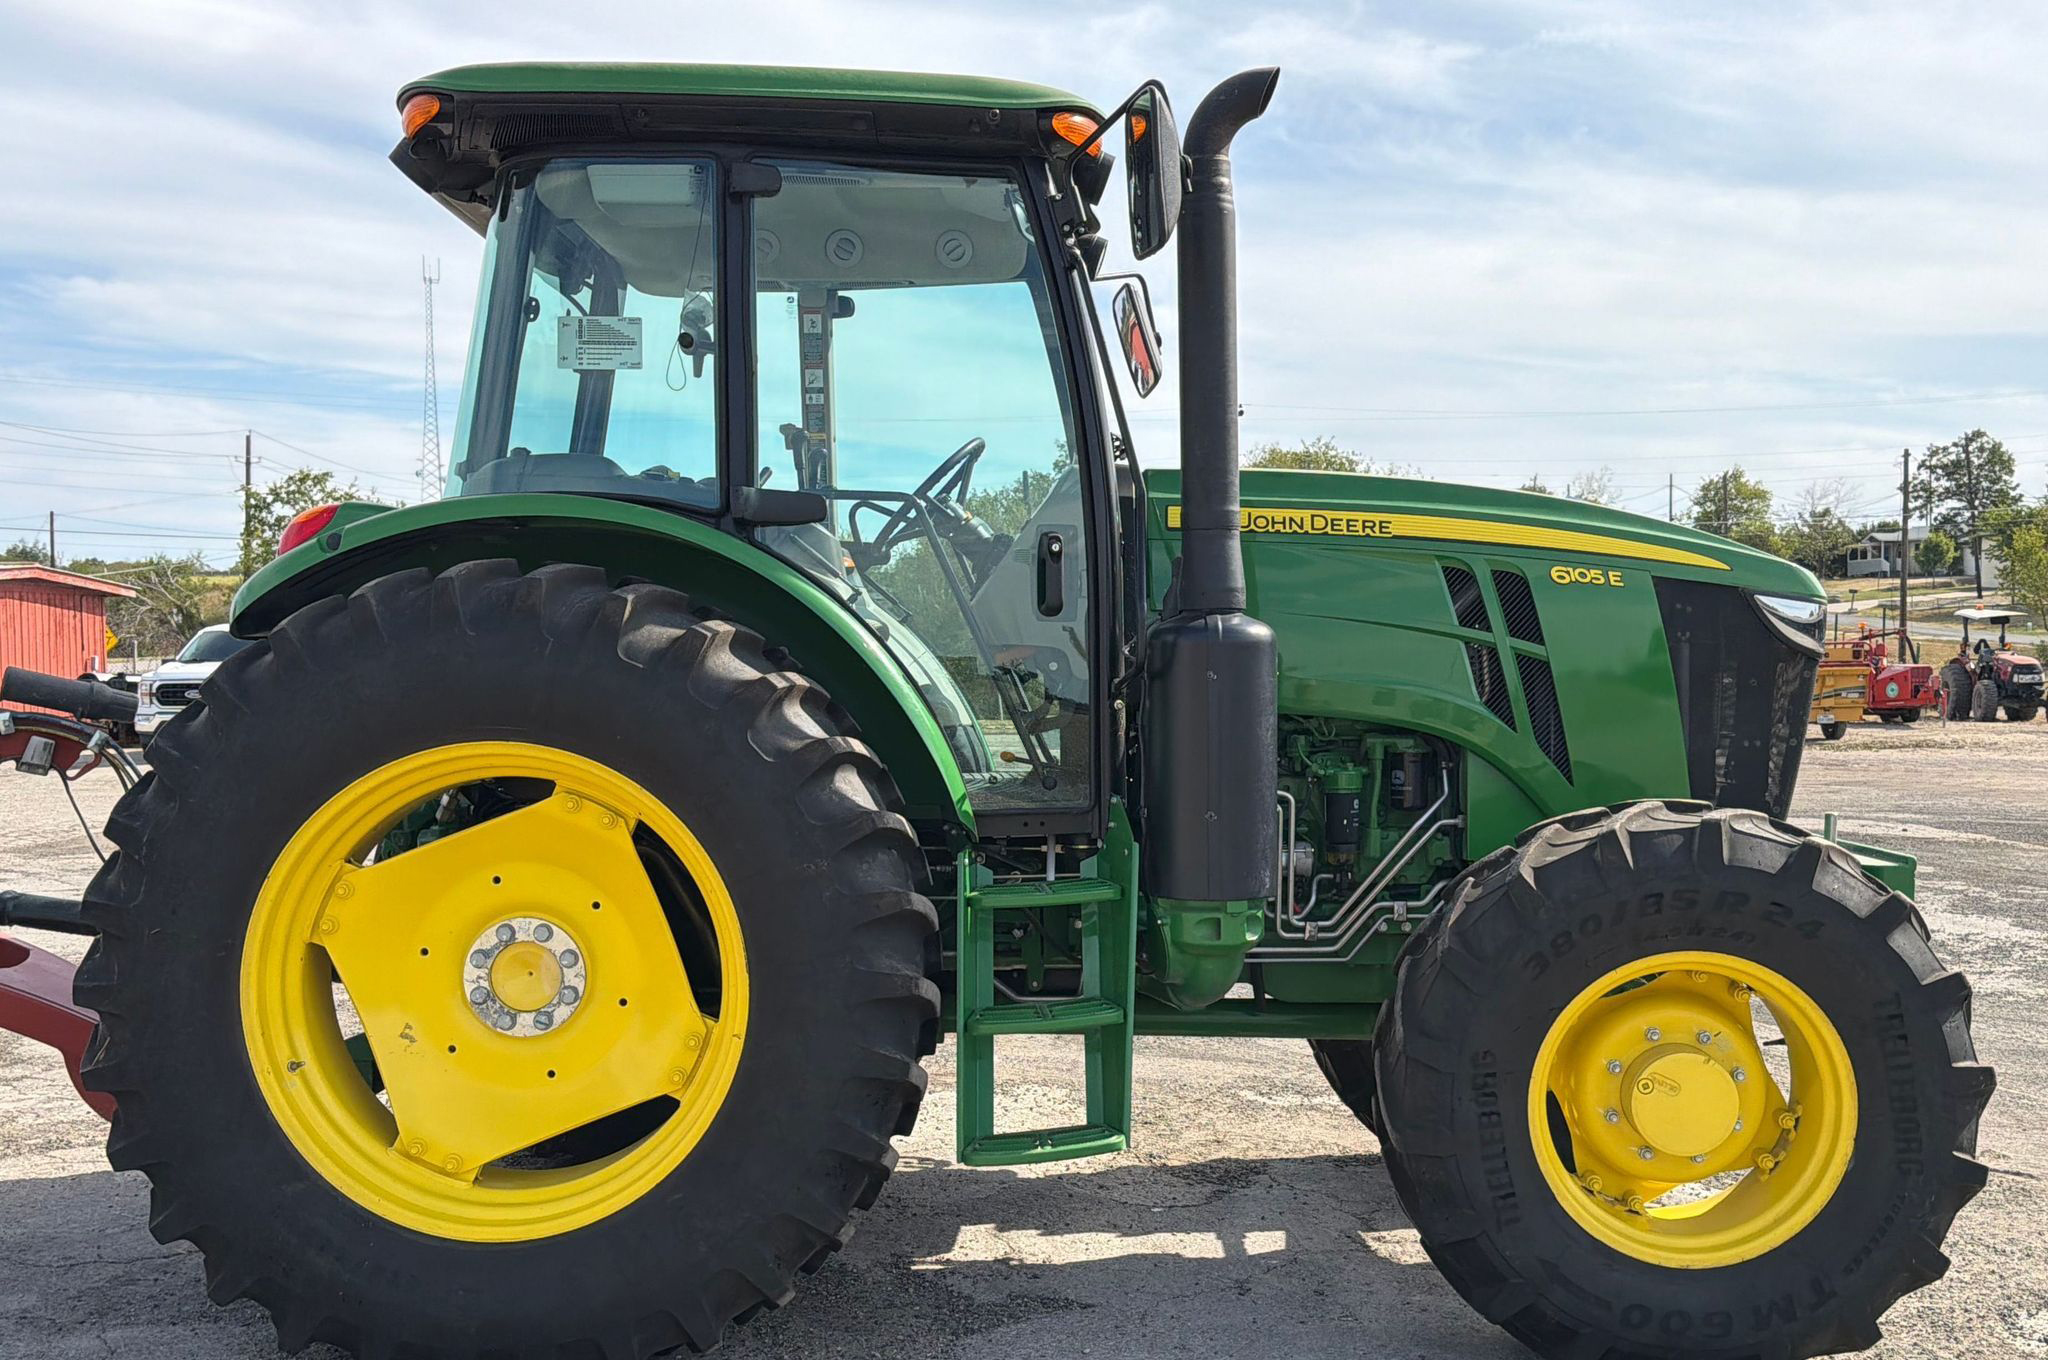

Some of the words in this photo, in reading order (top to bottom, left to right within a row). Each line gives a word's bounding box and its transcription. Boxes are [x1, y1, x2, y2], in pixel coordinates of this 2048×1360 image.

[1241, 511, 1304, 531] JOHN
[1310, 514, 1392, 534] DEERE
[1550, 565, 1606, 585] 6105
[1607, 570, 1625, 587] E
